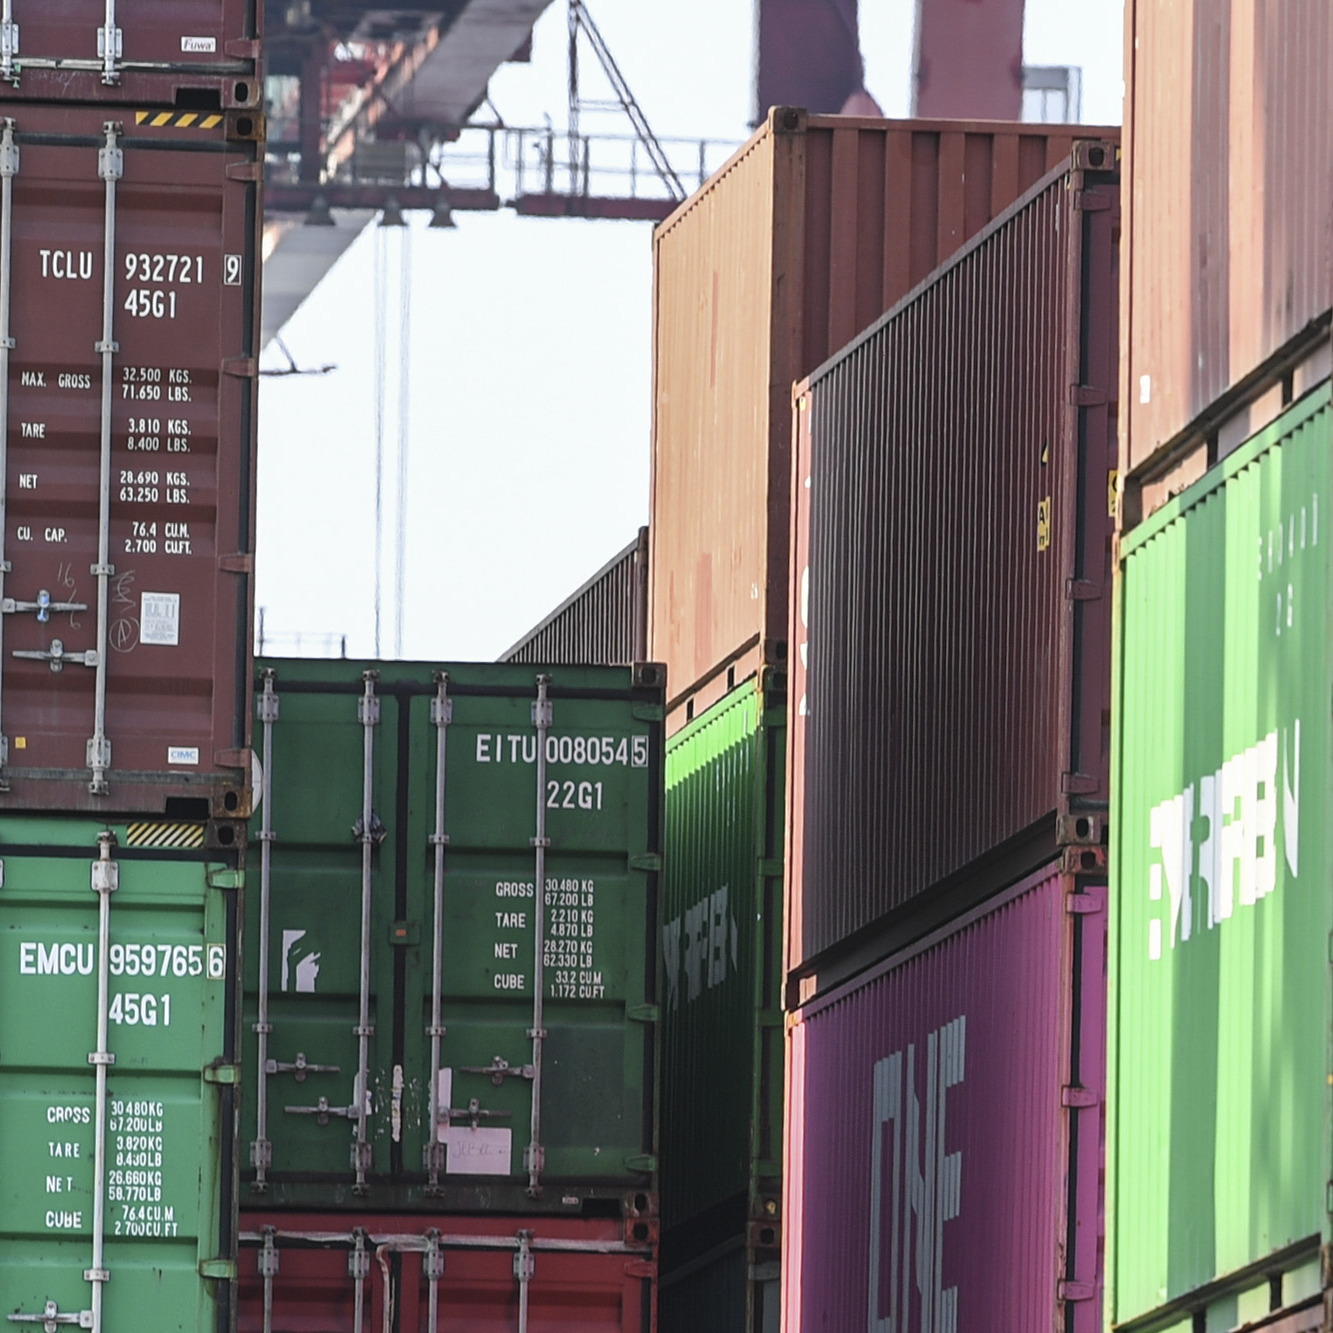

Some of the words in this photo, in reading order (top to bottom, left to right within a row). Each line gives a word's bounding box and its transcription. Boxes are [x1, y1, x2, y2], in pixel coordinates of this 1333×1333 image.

[183, 39, 215, 51] Fuwa
[40, 250, 92, 279] TCLU
[126, 254, 202, 283] 932721
[125, 289, 175, 318] 45G1
[22, 372, 46, 386] MAX.
[59, 374, 90, 388] GROSS
[123, 367, 160, 382] 32.500
[123, 384, 160, 400] 71.650
[22, 423, 45, 438] TARE
[129, 418, 160, 433] 3.810
[128, 437, 159, 450] 8.400
[20, 475, 37, 488] NET
[121, 471, 158, 484] 28.690
[120, 487, 158, 502] 63.250
[133, 522, 156, 536] 76.4
[125, 539, 156, 552] 2.700
[477, 734, 536, 762] EITU
[546, 737, 627, 765] 008054
[547, 781, 602, 809] 22G1
[496, 882, 533, 897] GROSS
[496, 913, 525, 927] TARE
[495, 944, 517, 958] NET
[21, 943, 93, 974] EMCU
[110, 944, 202, 976] 959765
[495, 974, 524, 989] CUBE
[109, 994, 169, 1025] 45G1
[49, 1142, 79, 1157] TARE
